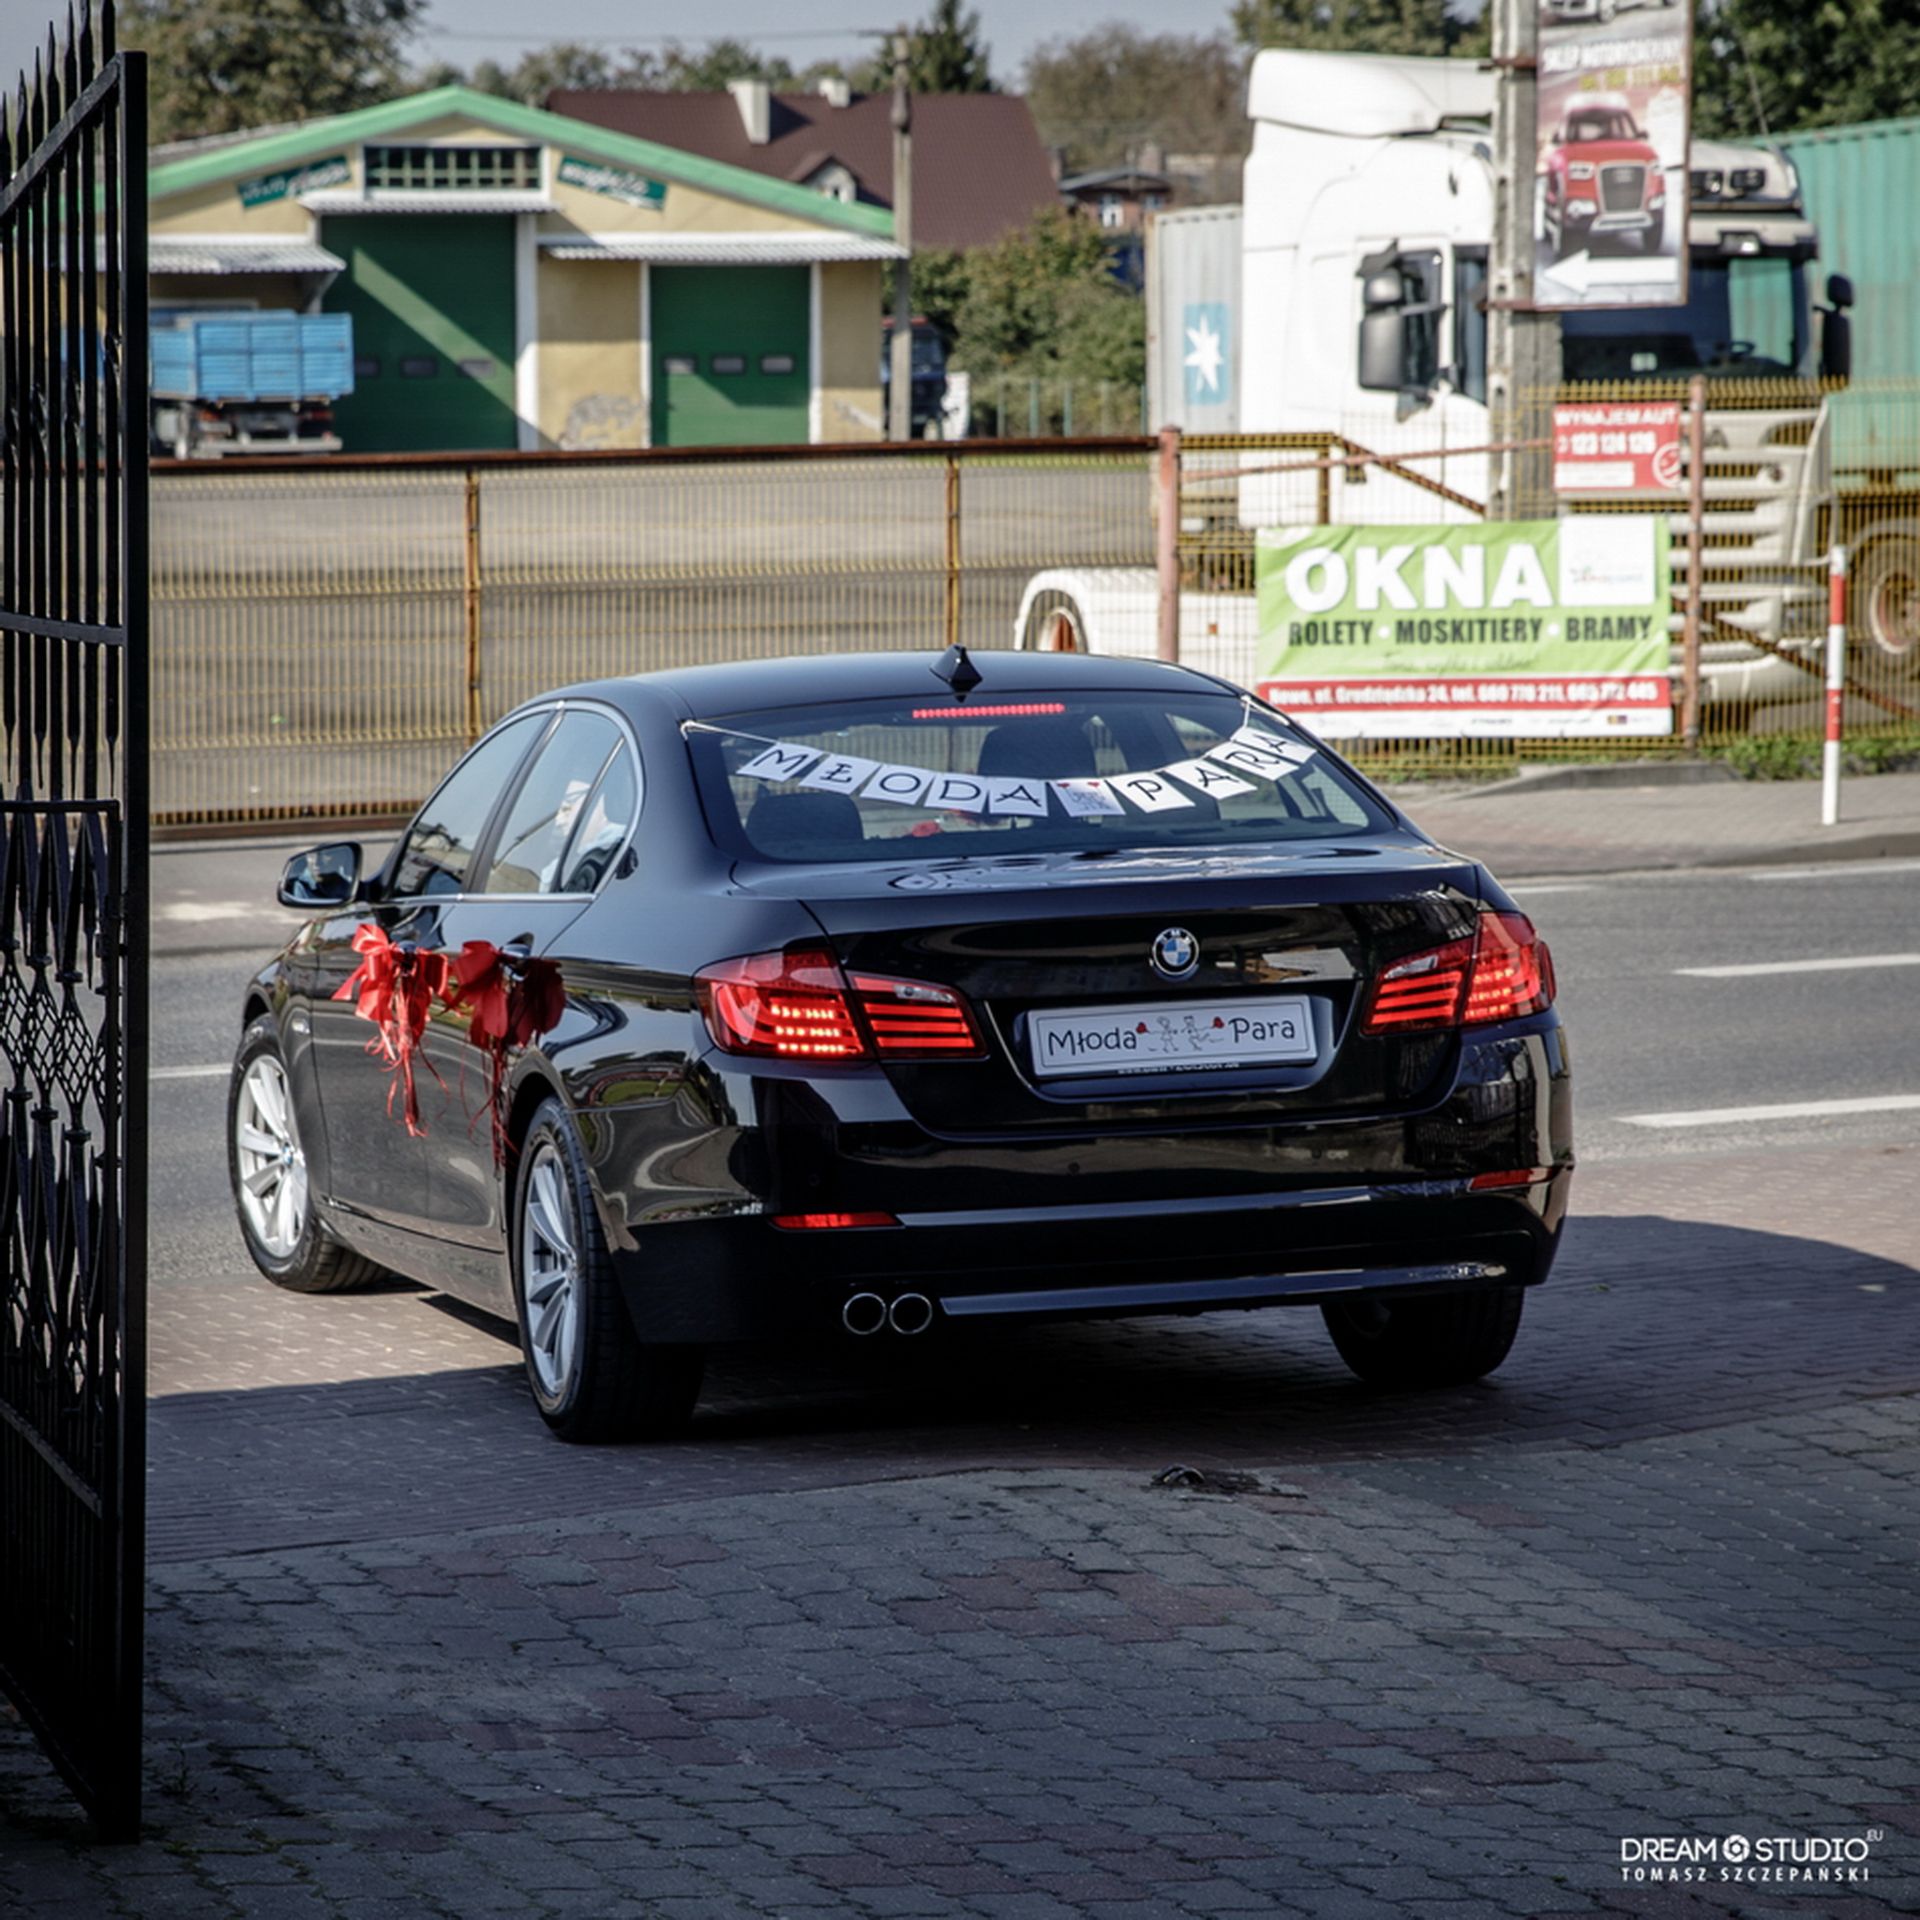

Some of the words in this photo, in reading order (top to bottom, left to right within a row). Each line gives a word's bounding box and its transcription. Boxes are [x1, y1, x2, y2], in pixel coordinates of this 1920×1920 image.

[1285, 544, 1553, 613] OKNA
[1289, 620, 1374, 646] ROLETY
[1395, 618, 1543, 644] MOSKITIERY
[1566, 615, 1653, 643] BRAMY
[1127, 734, 1287, 801] PARA
[1048, 1026, 1137, 1057] Młoda
[1228, 1017, 1296, 1044] Para
